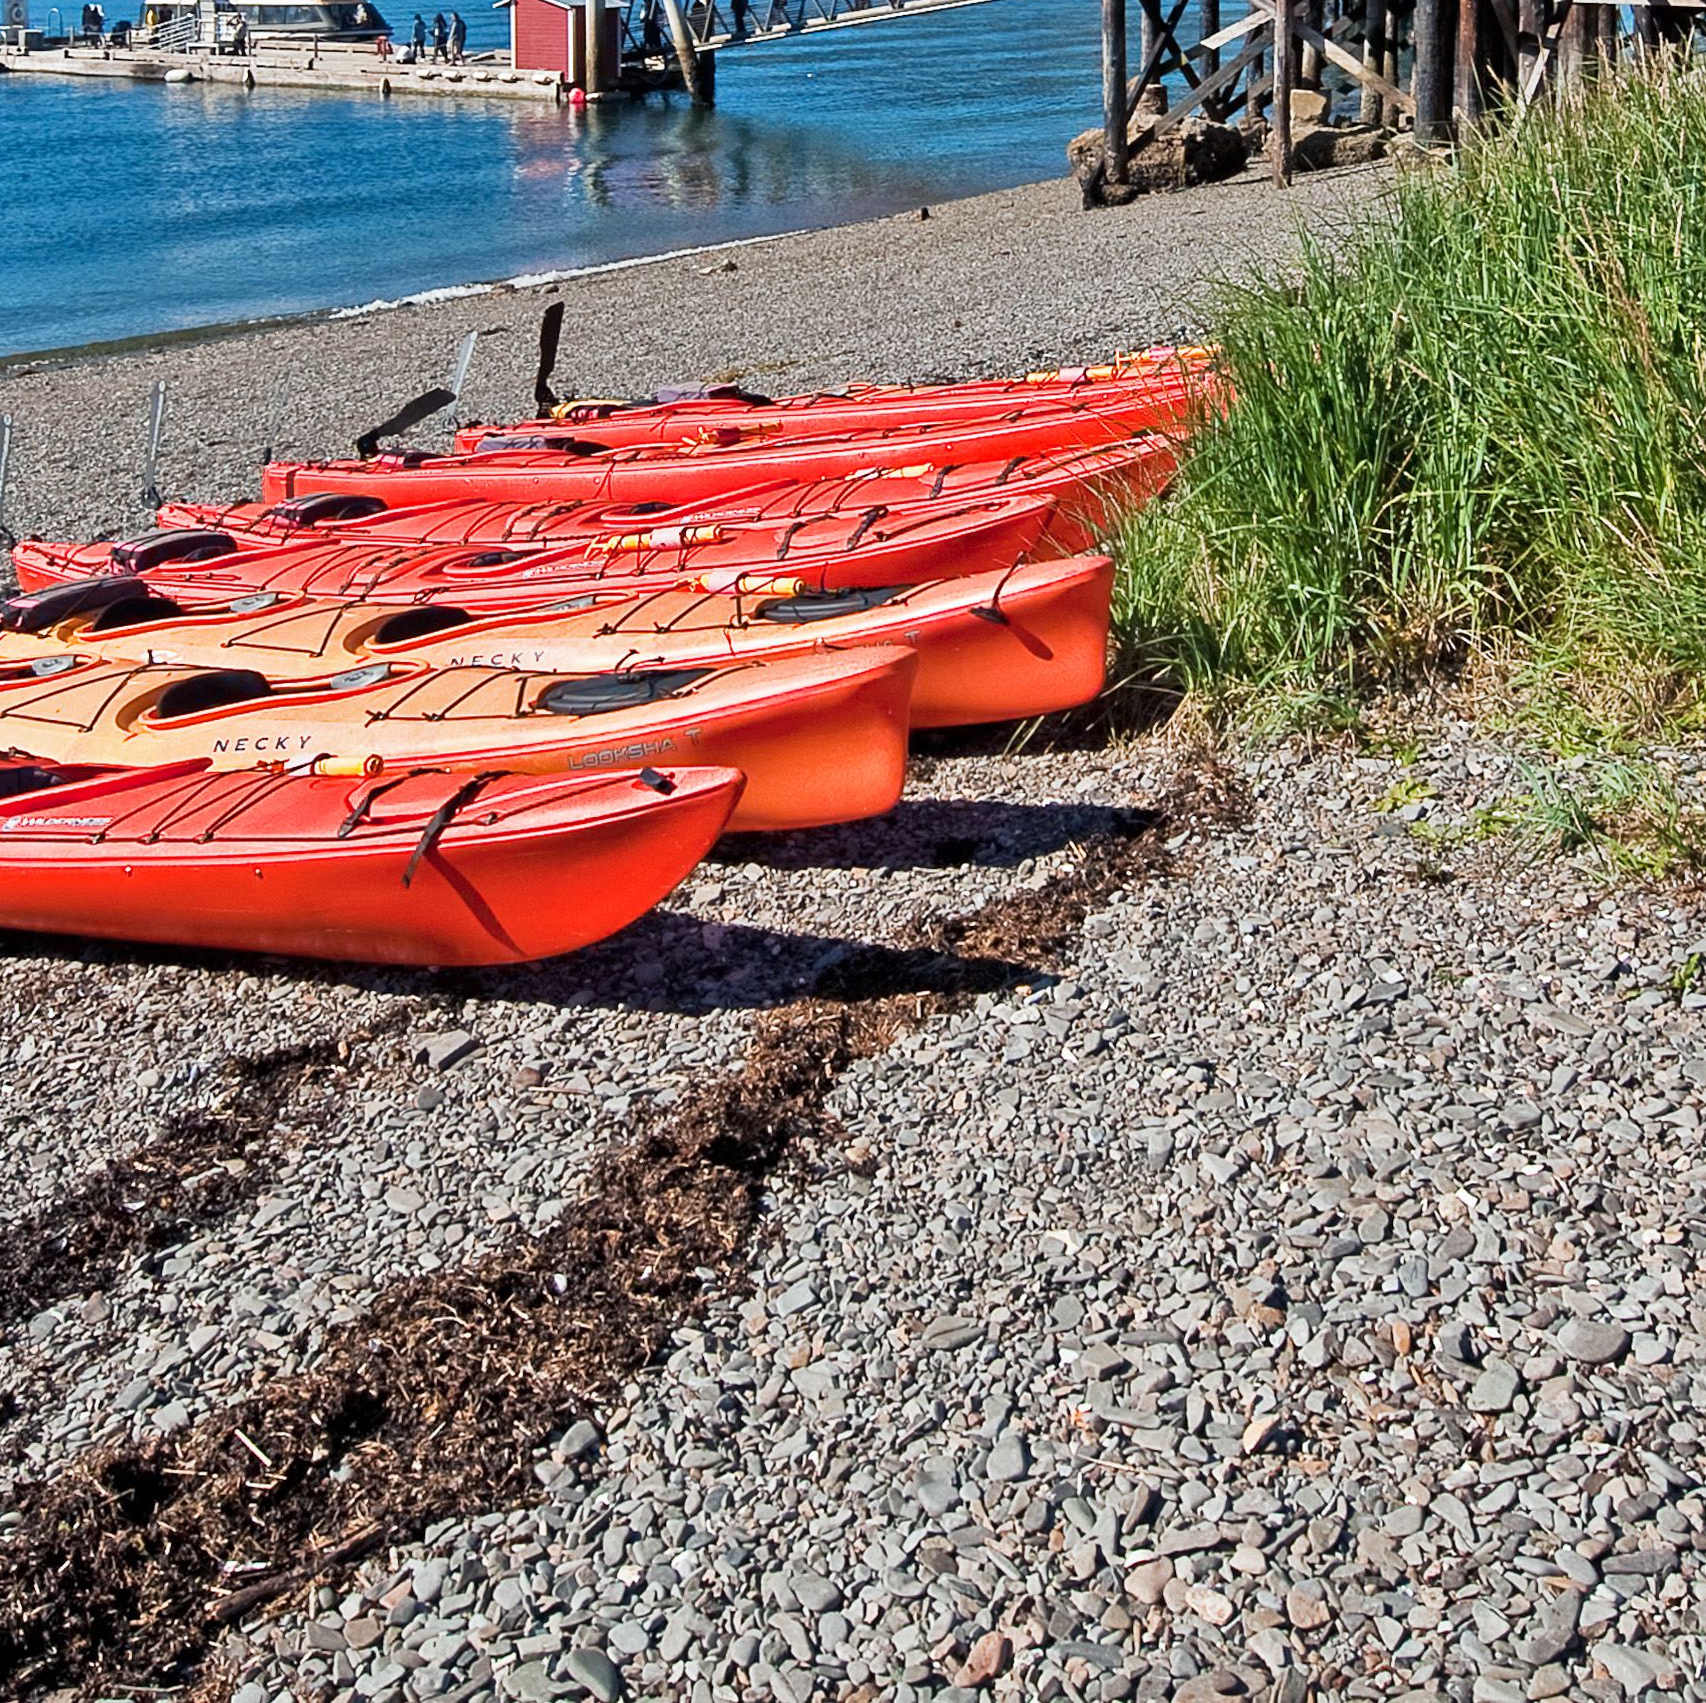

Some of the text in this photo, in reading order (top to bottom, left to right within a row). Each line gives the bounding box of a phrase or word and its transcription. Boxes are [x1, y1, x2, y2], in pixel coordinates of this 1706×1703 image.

[451, 651, 544, 666] NECKY
[213, 736, 311, 752] NECKY
[567, 727, 702, 770] LOOKSHA T
